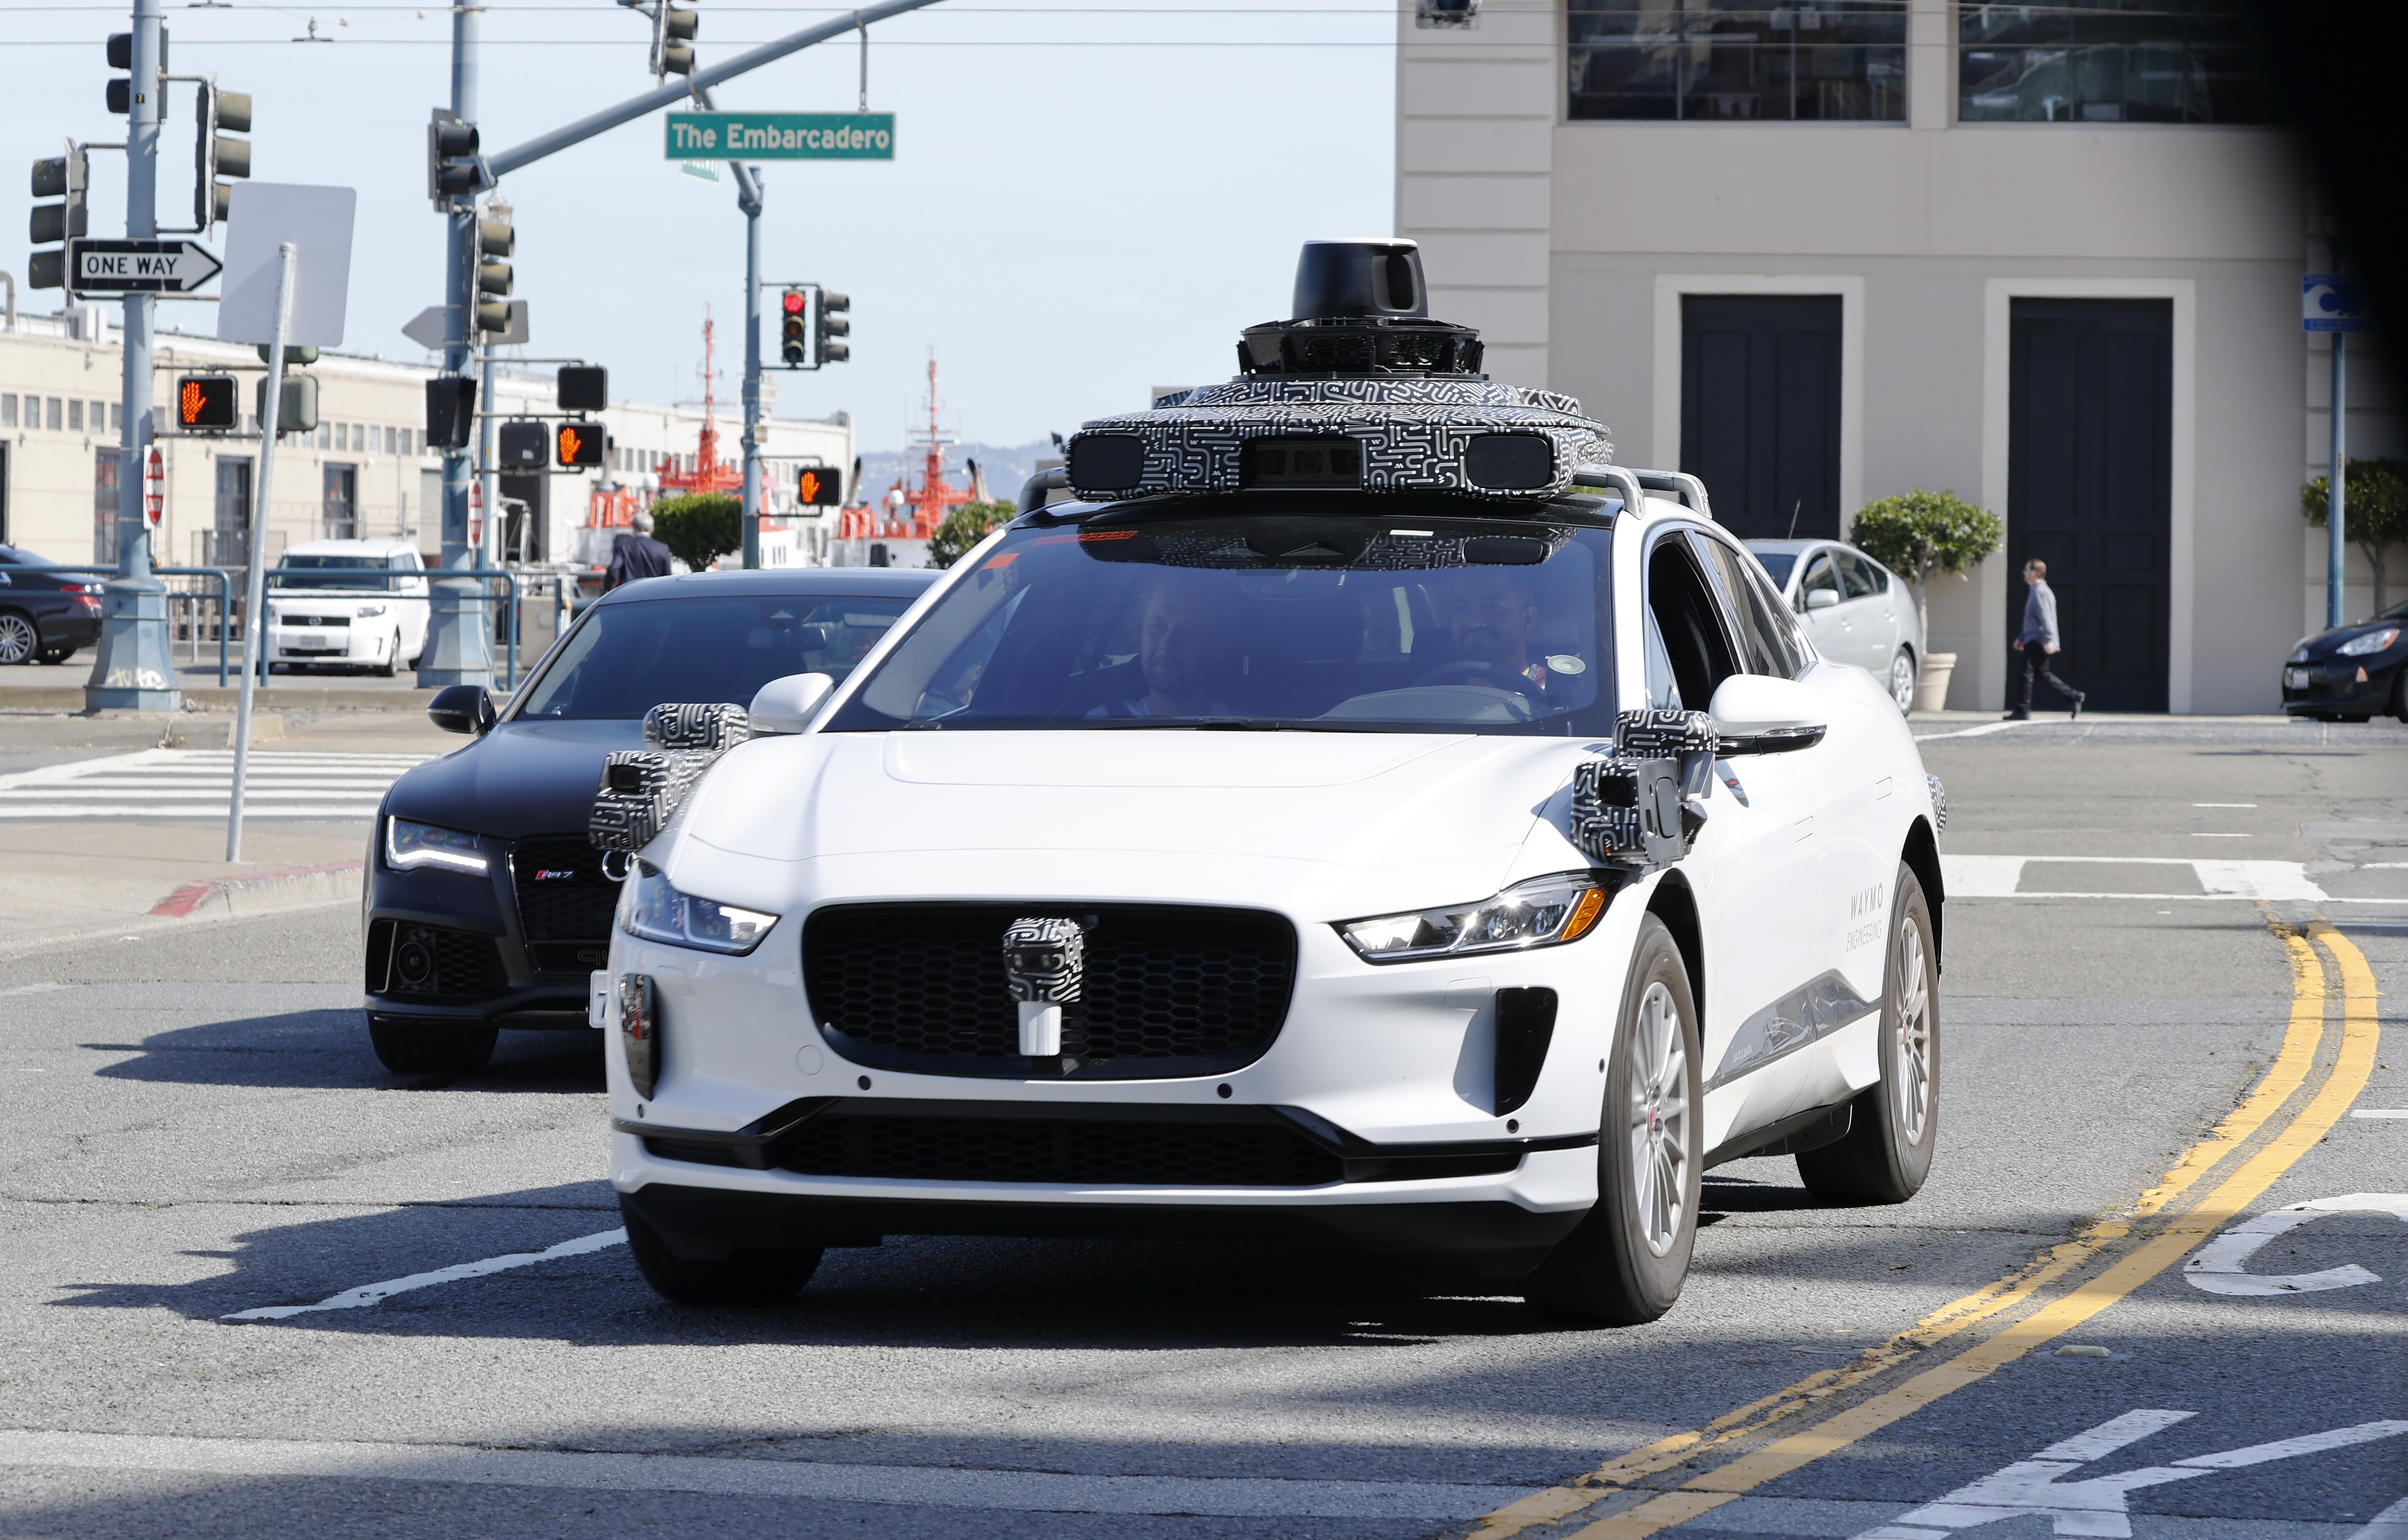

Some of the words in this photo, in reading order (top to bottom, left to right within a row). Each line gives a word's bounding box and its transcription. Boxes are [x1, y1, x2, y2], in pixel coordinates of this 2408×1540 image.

[672, 123, 717, 149] The
[727, 123, 890, 149] Embarcadero
[87, 256, 127, 274] ONE
[137, 257, 177, 274] WAY
[1851, 882, 1883, 920] WAYMO
[1846, 919, 1882, 952] ENGINEERING
